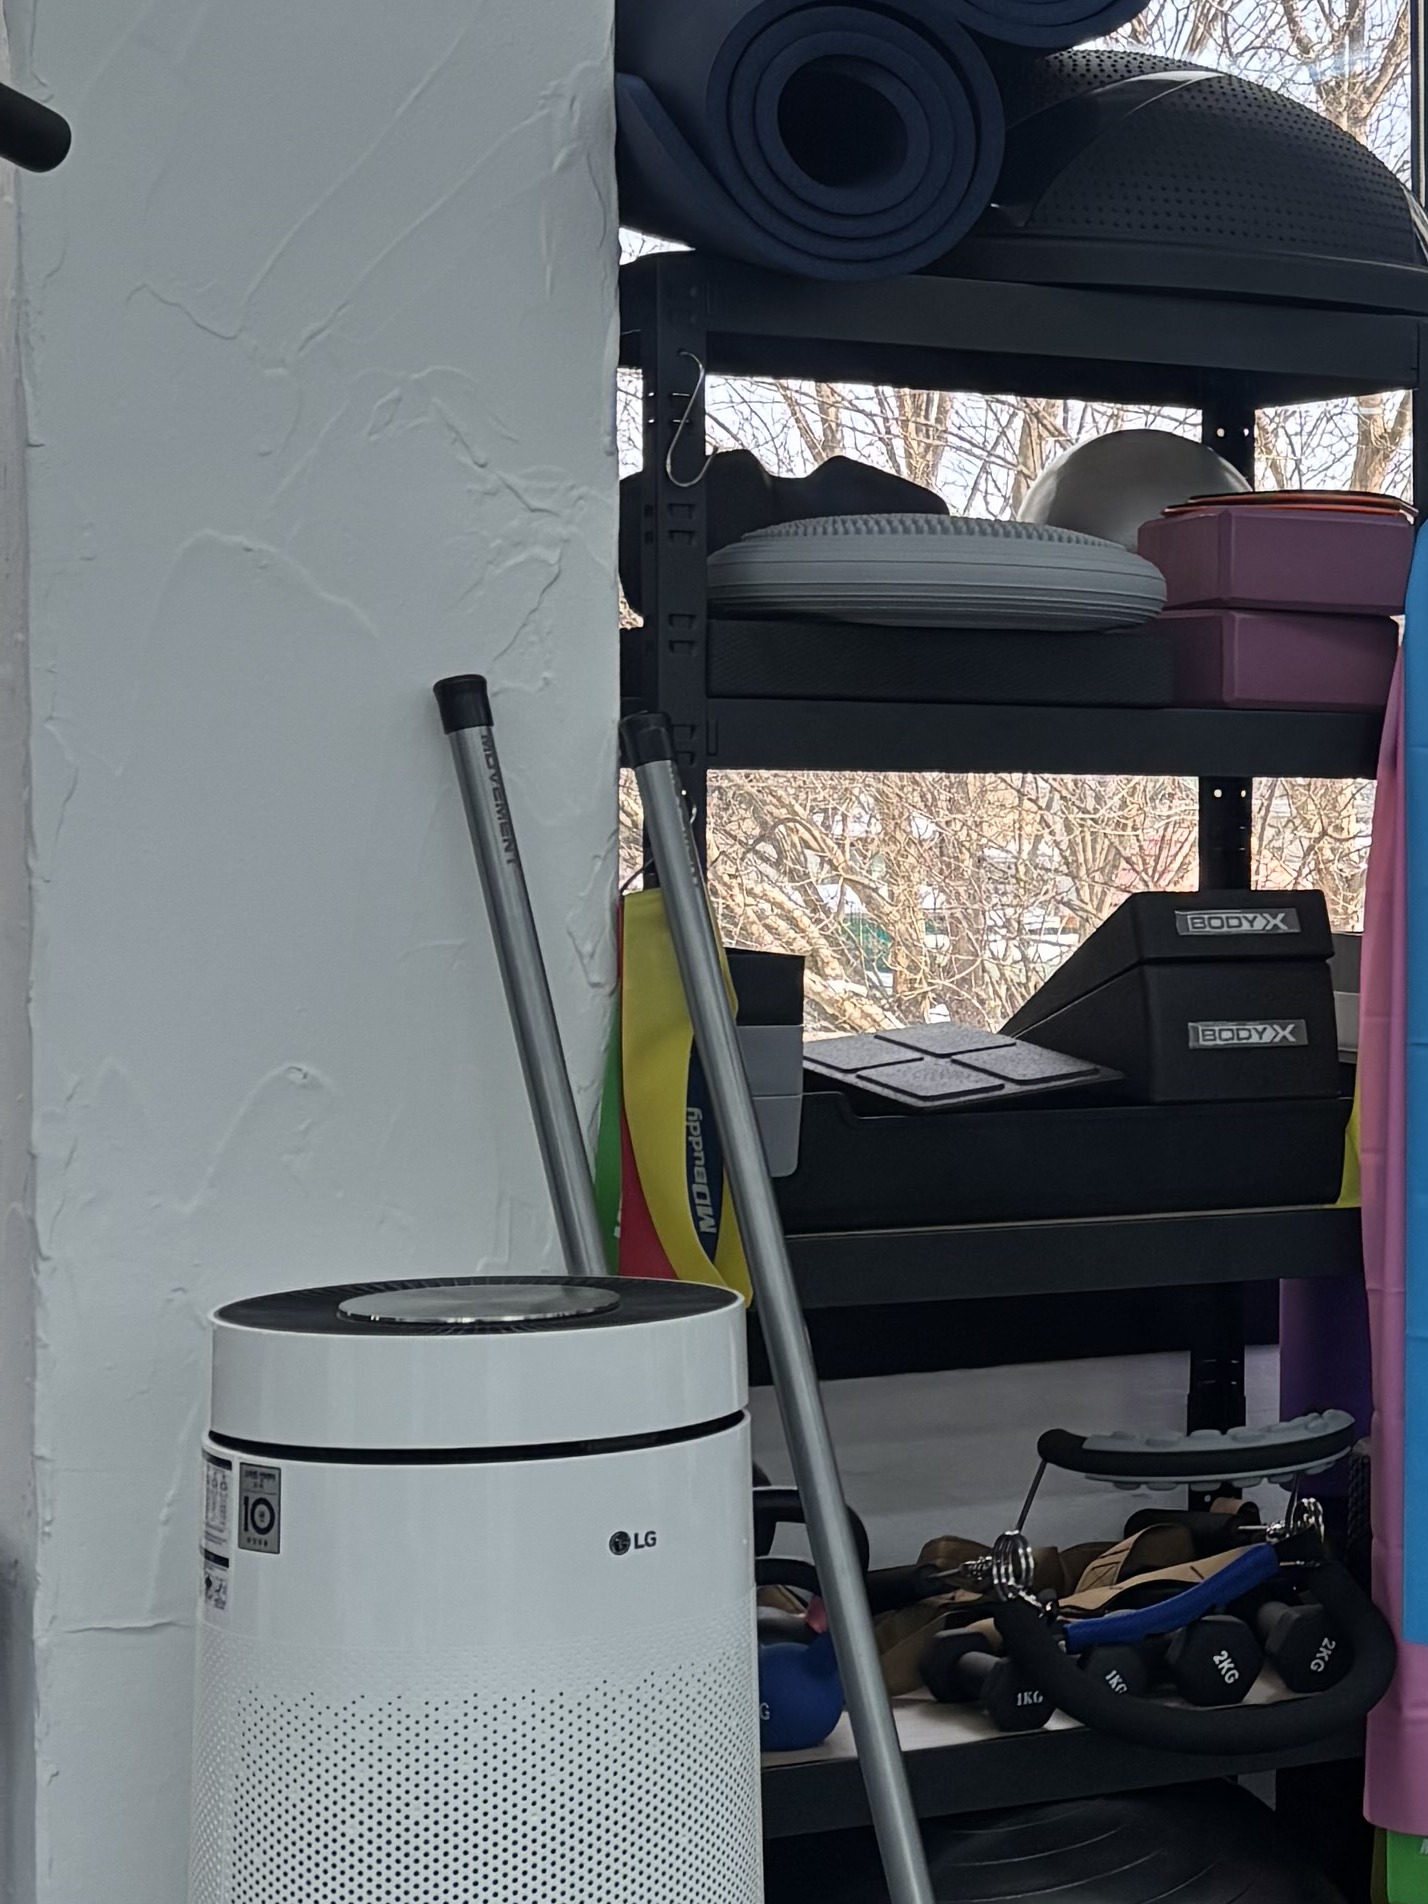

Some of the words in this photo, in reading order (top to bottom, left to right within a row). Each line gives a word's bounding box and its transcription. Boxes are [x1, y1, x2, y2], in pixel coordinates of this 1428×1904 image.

[634, 1530, 657, 1551] LG
[1212, 1649, 1240, 1685] 2KG
[1310, 1637, 1337, 1673] 2KG
[1105, 1669, 1129, 1695] 1KG
[1016, 1689, 1044, 1707] 1KG
